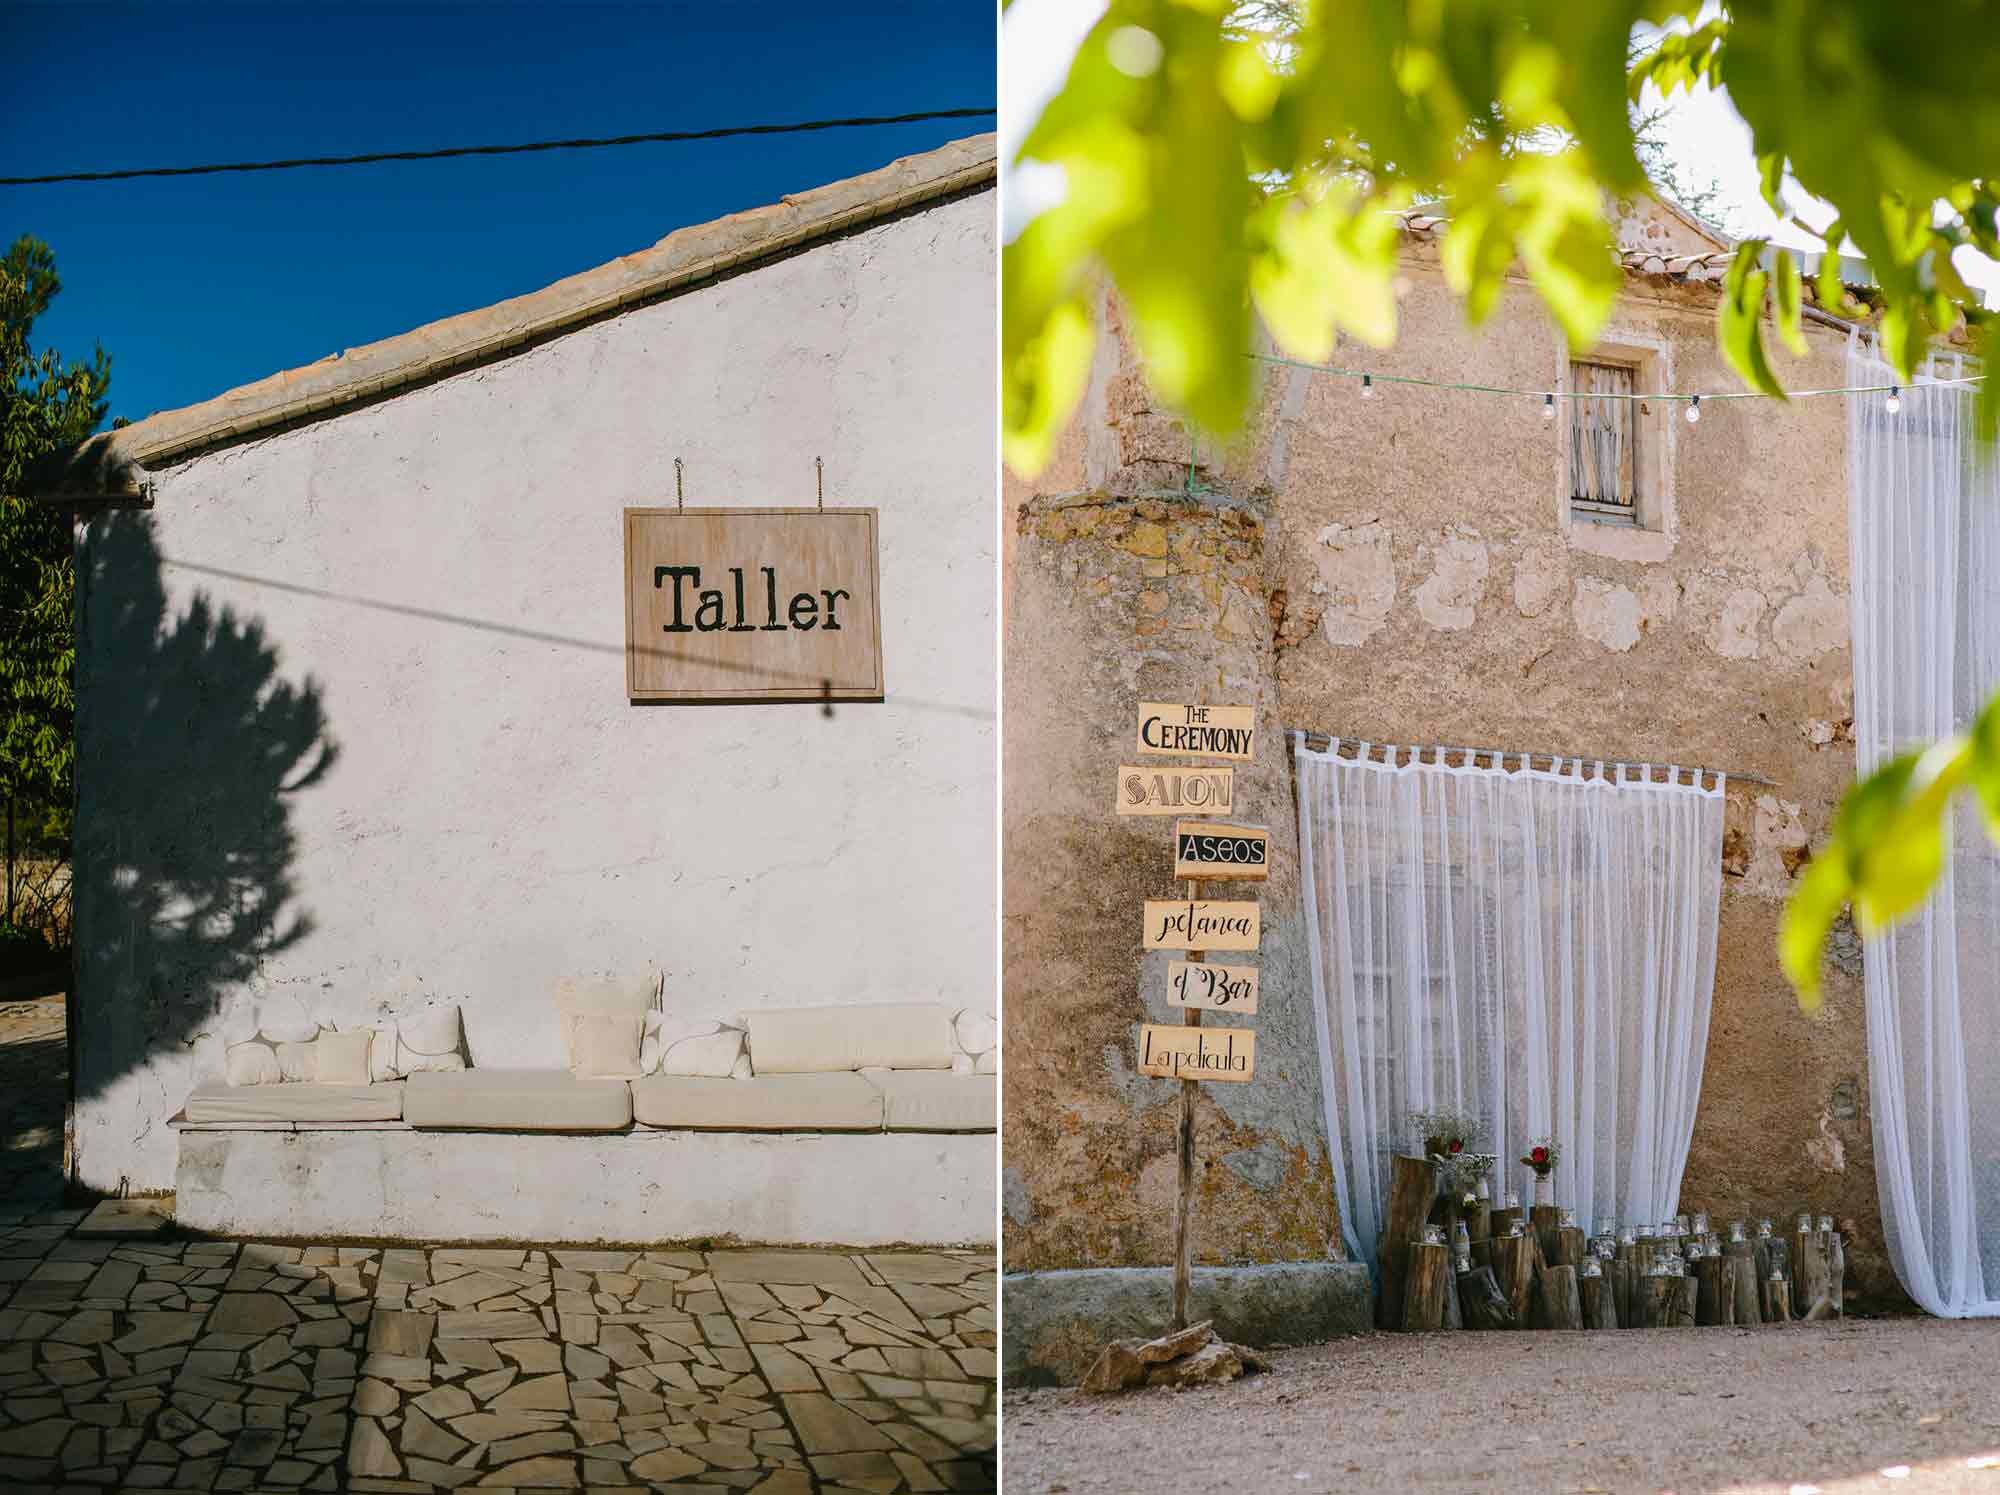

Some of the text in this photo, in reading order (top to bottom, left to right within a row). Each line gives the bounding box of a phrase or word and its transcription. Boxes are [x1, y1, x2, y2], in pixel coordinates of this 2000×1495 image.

[654, 566, 850, 632] Taller
[1184, 704, 1210, 724] THE
[1141, 716, 1253, 754] CEREMONY
[1194, 967, 1254, 1006] Bar
[1144, 1031, 1170, 1066] La
